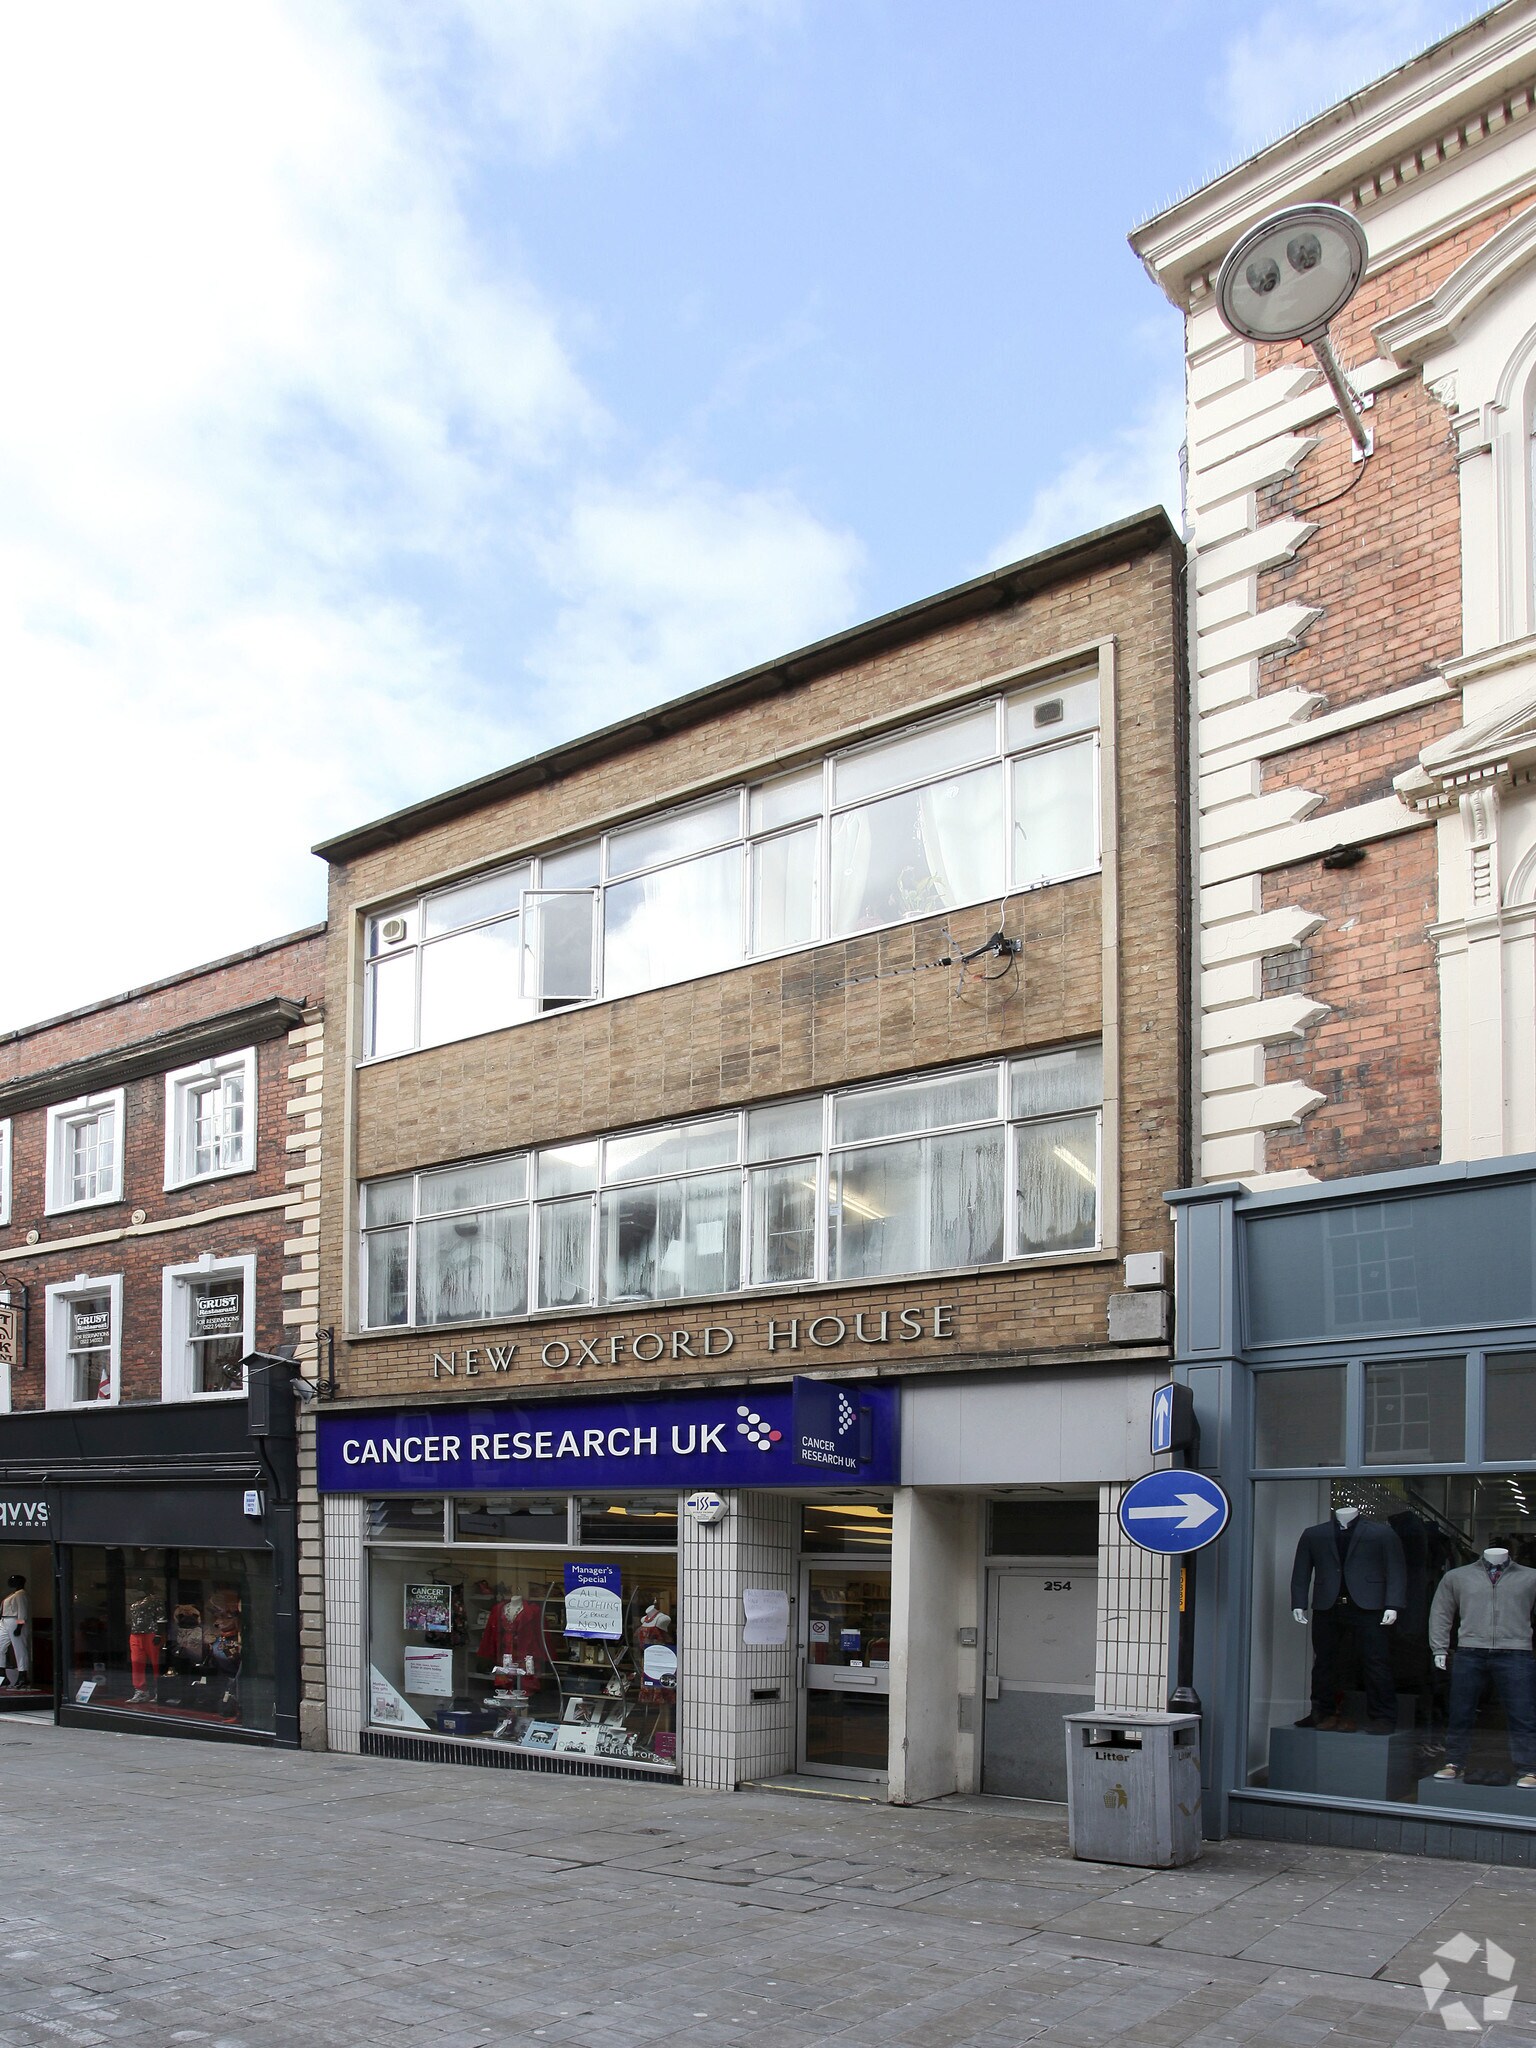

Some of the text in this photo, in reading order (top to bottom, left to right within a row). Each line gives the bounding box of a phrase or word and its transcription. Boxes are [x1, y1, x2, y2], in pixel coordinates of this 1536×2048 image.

[433, 1304, 955, 1378] NEW OXFORD HOUSE
[342, 1423, 727, 1465] CANCER RESEARCH UK
[802, 1436, 835, 1452] CANCER
[802, 1449, 857, 1469] RESEARCH UK
[572, 1565, 613, 1576] Manager's
[578, 1574, 607, 1584] Special
[1043, 1581, 1072, 1591] 254
[568, 1597, 620, 1612] CLOTHING
[1095, 1751, 1130, 1762] Litter
